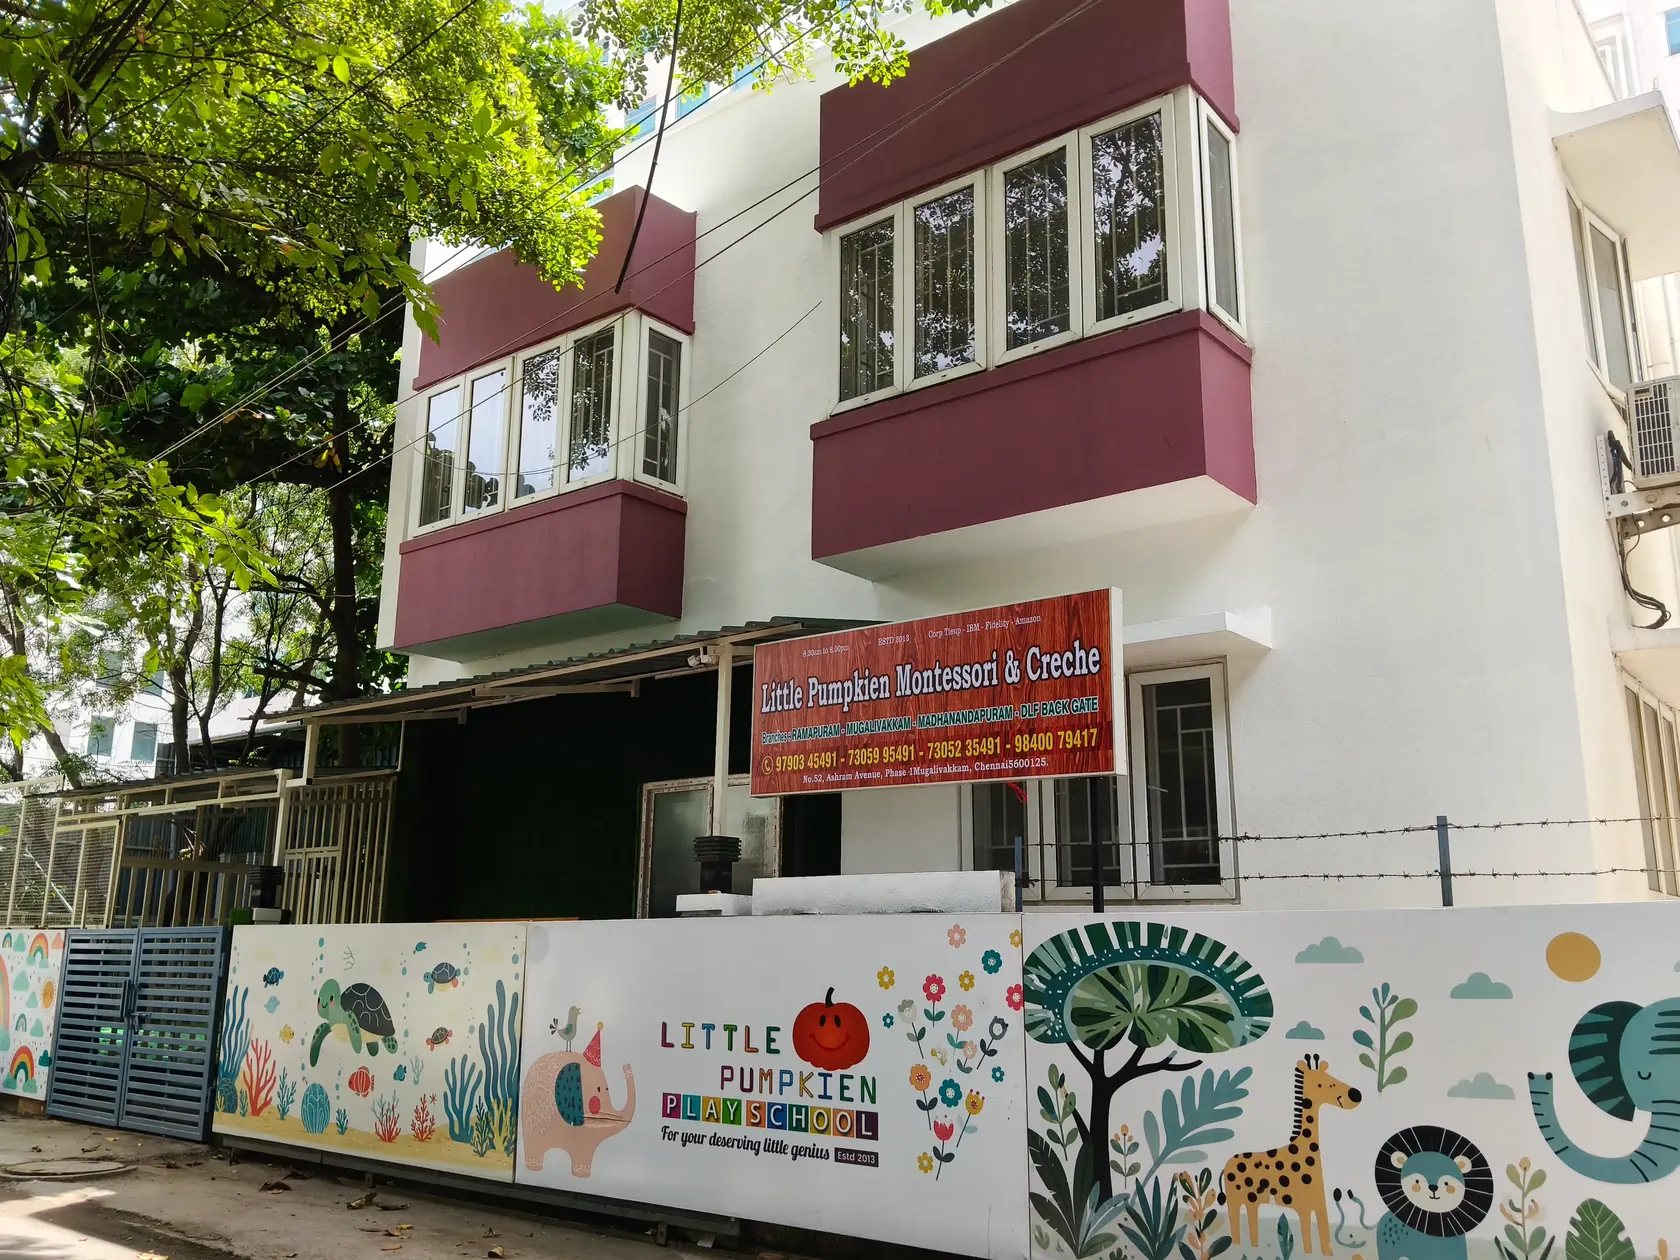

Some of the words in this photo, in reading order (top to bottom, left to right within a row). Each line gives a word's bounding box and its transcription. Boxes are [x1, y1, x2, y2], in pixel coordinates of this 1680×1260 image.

[878, 636, 894, 646] ESTD
[895, 634, 910, 643] 2013
[928, 629, 943, 638] Corp
[966, 623, 980, 633] IBM
[985, 619, 1009, 629] Fidelity
[1015, 615, 1041, 625] Amazon
[761, 679, 803, 714] Little
[807, 668, 890, 713] Pumpkien
[895, 650, 999, 698] Montessori
[1004, 649, 1021, 685] &
[1026, 638, 1100, 682] Creche
[792, 723, 841, 742] RAMAPURAM
[846, 716, 911, 737] MUGALIVAKKAM
[917, 705, 1014, 729] MADHANANDAPURAM
[1021, 702, 1040, 720] DLF
[1041, 700, 1069, 717] BACK
[1071, 696, 1099, 715] GATE
[776, 754, 805, 772] 97903
[807, 751, 837, 769] 45491
[848, 747, 880, 766] 73059
[883, 744, 915, 763] 95491
[928, 741, 962, 760] 73052
[965, 736, 1000, 757] 35491
[1014, 732, 1053, 752] 98400
[1057, 728, 1098, 750] 79417
[826, 772, 852, 782] Ashram
[854, 771, 883, 780] Avenue,
[885, 768, 907, 778] Phase
[661, 1021, 781, 1054] LITTLE
[720, 1065, 877, 1104] PUMPKIEN
[661, 1125, 679, 1142] For
[681, 1130, 707, 1147] your
[709, 1131, 760, 1156] deserving
[763, 1137, 789, 1155] little
[790, 1143, 830, 1161] genius
[837, 1151, 855, 1161] Estd
[857, 1152, 876, 1164] 2013
